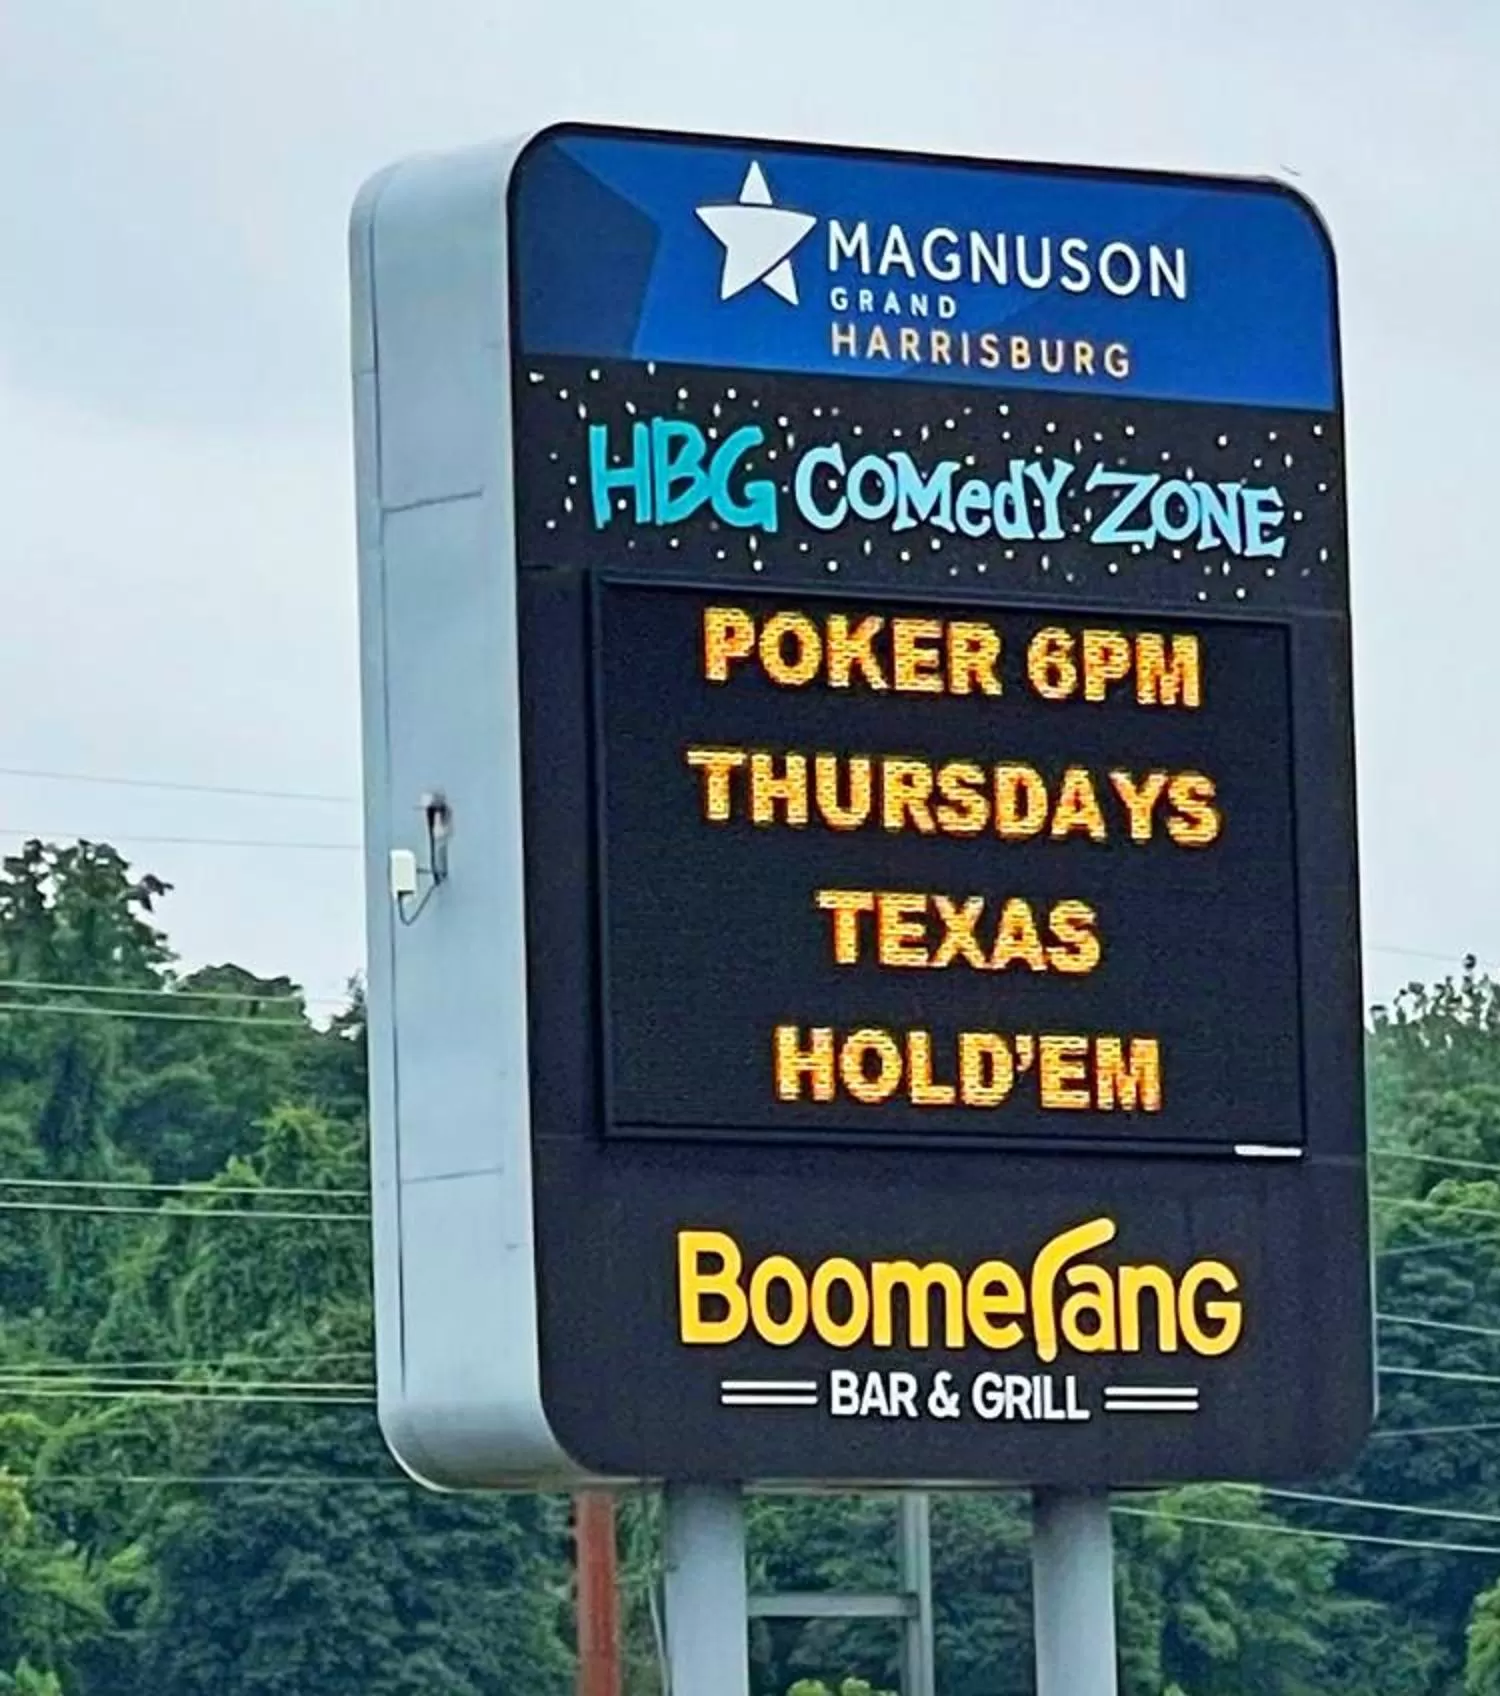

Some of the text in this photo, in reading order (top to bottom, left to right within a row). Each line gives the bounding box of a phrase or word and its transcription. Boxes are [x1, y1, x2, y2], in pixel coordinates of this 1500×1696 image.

[826, 218, 1189, 301] MAGNUSON
[830, 288, 958, 319] GRAND
[830, 323, 1131, 379] HARRISBURG
[588, 418, 780, 533] HBG
[1088, 462, 1286, 558] ZONE
[702, 607, 1202, 707] POKER 6PM
[687, 747, 1221, 846] THURSDAYS
[816, 889, 1102, 974] TEXAS
[830, 1369, 1090, 1421] BAR & GRILL
